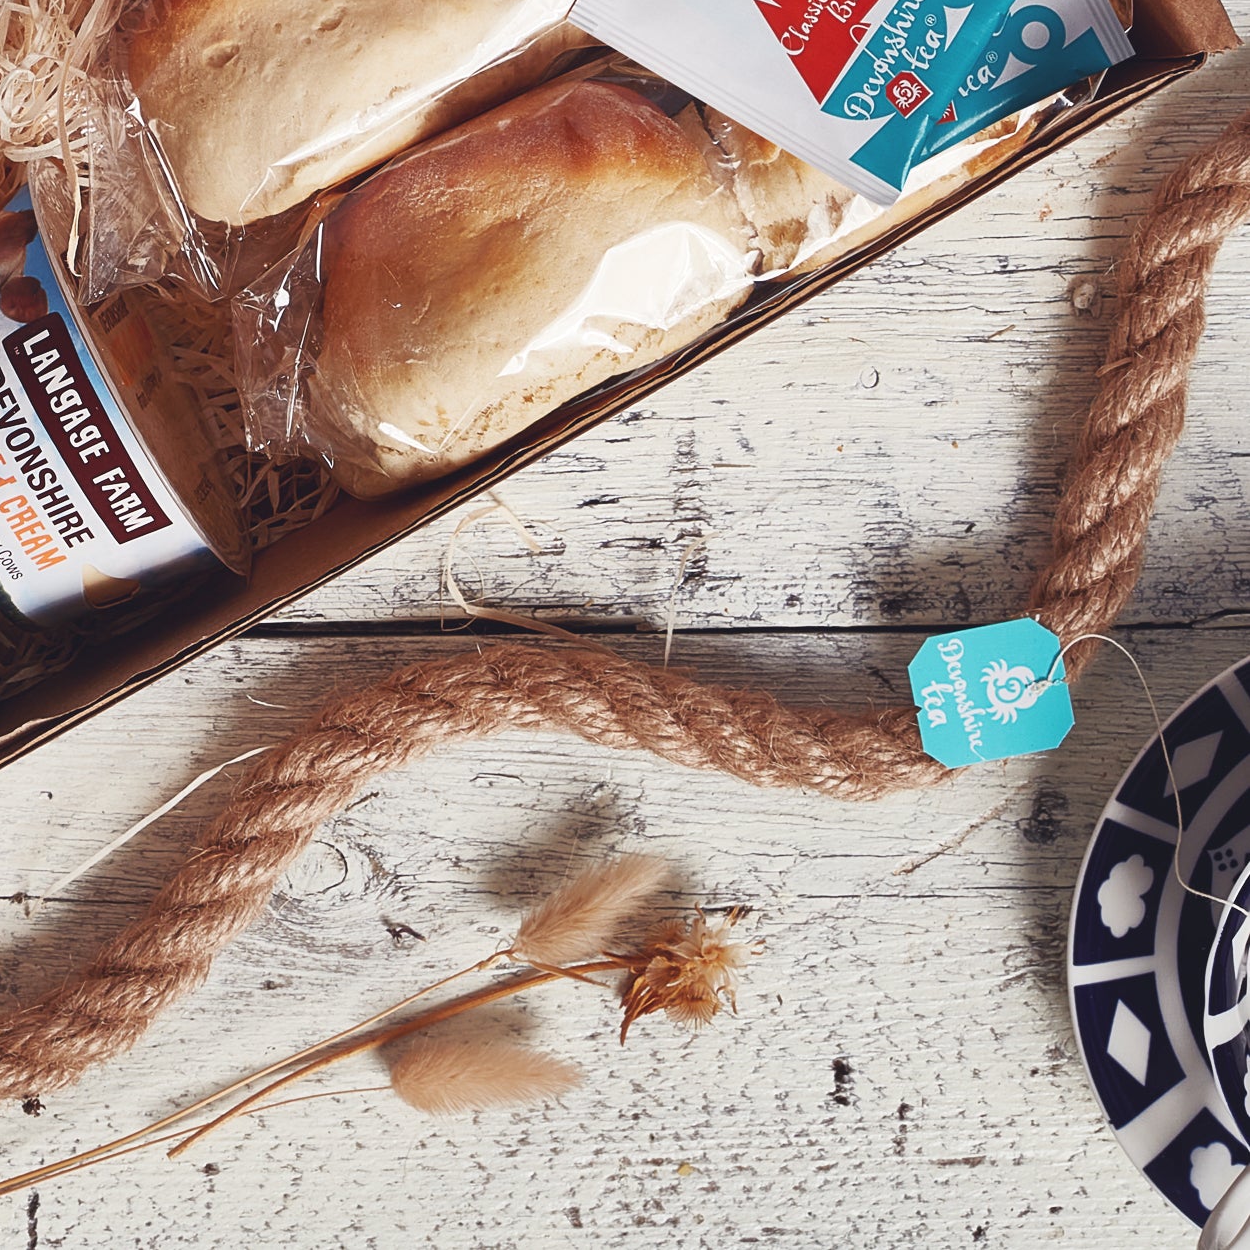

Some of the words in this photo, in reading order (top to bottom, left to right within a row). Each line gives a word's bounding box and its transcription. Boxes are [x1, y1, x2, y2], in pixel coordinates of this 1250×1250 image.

[92, 466, 155, 534] FARM
[921, 680, 954, 728] tea
[937, 638, 986, 762] Devonshire
